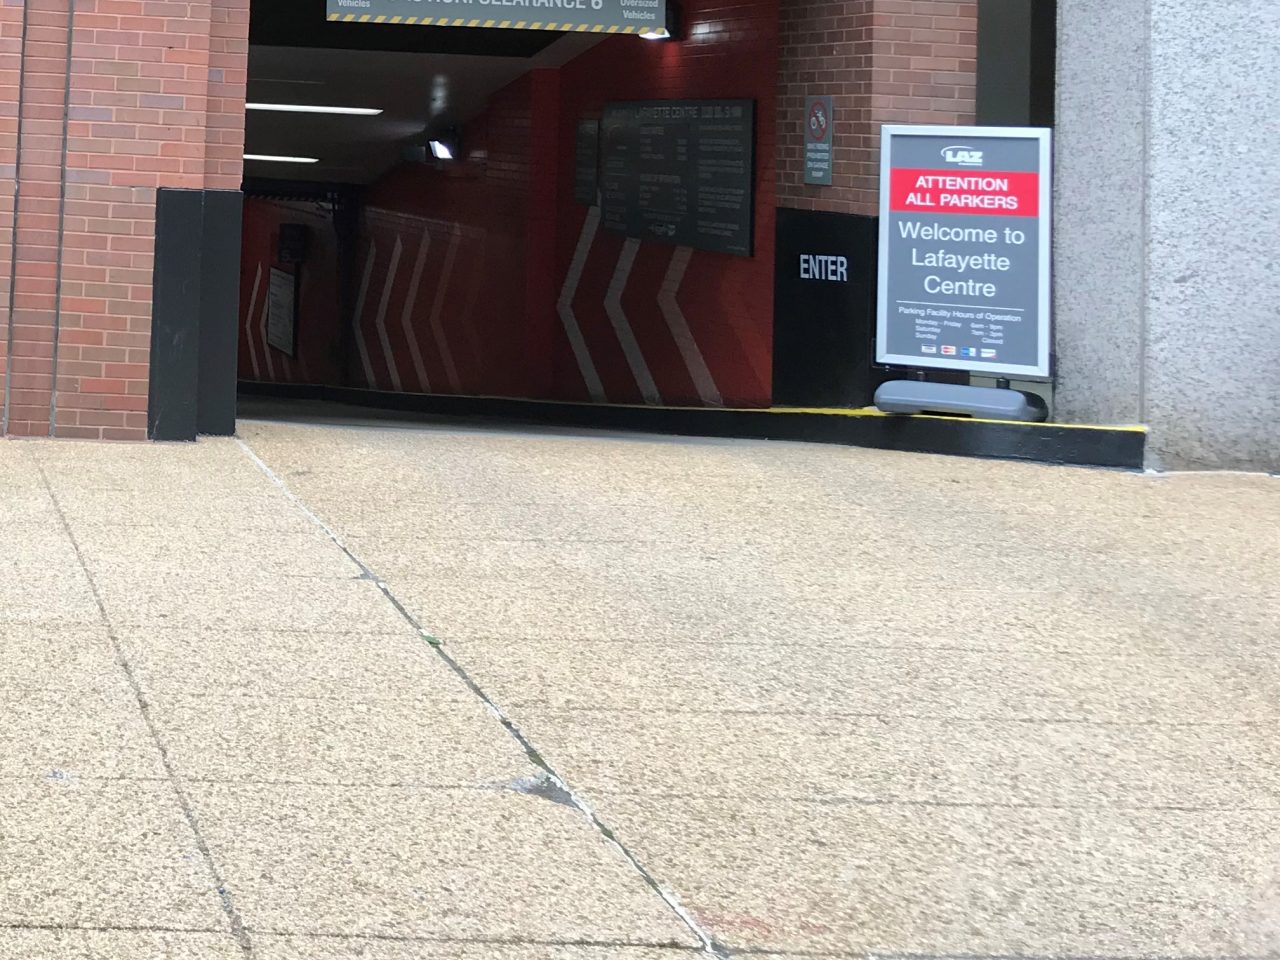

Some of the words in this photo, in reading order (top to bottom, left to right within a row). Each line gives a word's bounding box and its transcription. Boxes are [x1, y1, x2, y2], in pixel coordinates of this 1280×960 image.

[623, 9, 655, 20] Vehicles
[945, 150, 983, 163] LAZ
[915, 176, 1008, 191] ATTENTION
[905, 192, 935, 206] ALL
[940, 194, 1018, 210] PARKERS
[898, 221, 998, 243] Welcome
[1003, 227, 1025, 244] to
[800, 254, 848, 281] ENTER
[912, 248, 1011, 272] Lafayette
[924, 275, 996, 297] Centre
[898, 306, 925, 316] Parking
[927, 309, 951, 318] Facility
[953, 311, 974, 319] Hours
[985, 313, 1021, 322] Operation
